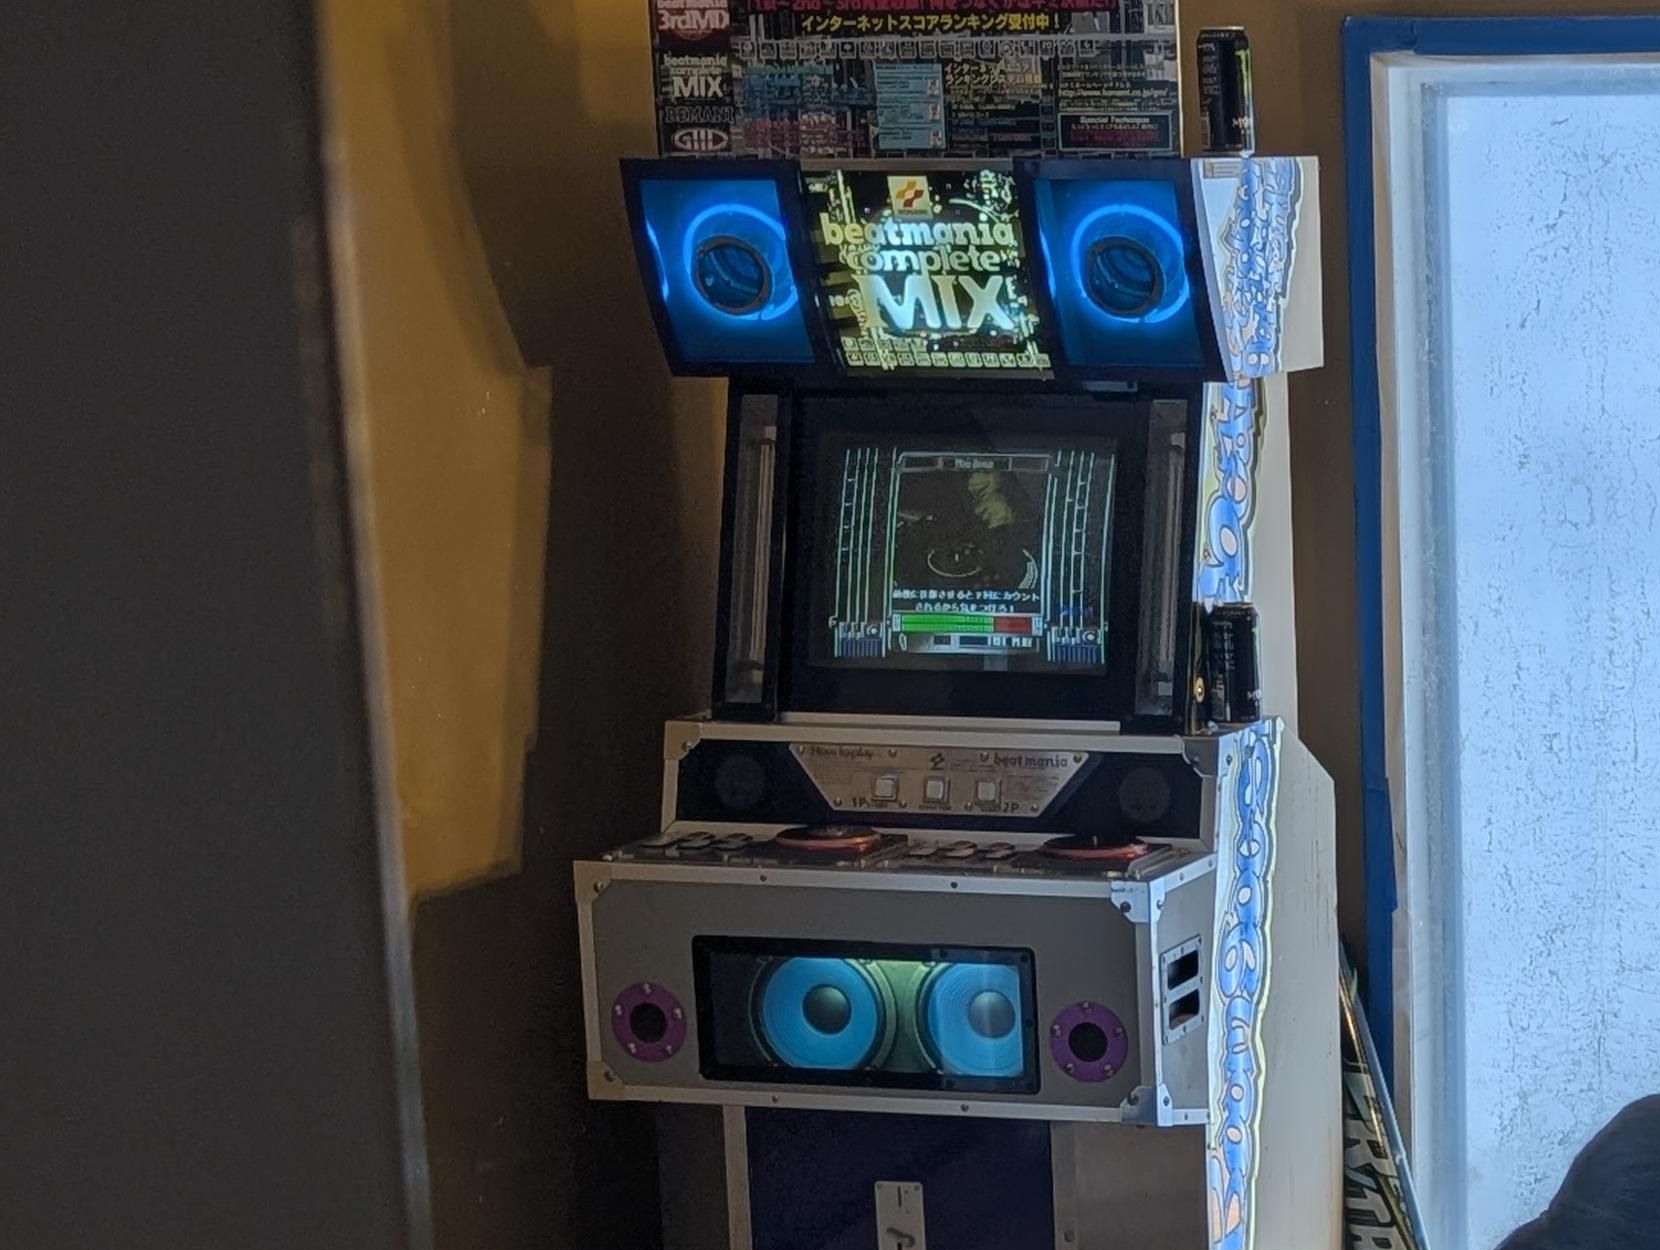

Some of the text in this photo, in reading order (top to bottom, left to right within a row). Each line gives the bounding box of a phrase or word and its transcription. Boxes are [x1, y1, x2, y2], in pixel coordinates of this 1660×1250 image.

[672, 75, 724, 98] MIX
[820, 213, 1015, 246] beatmania
[848, 246, 1001, 274] complete
[851, 274, 1016, 331] MIX
